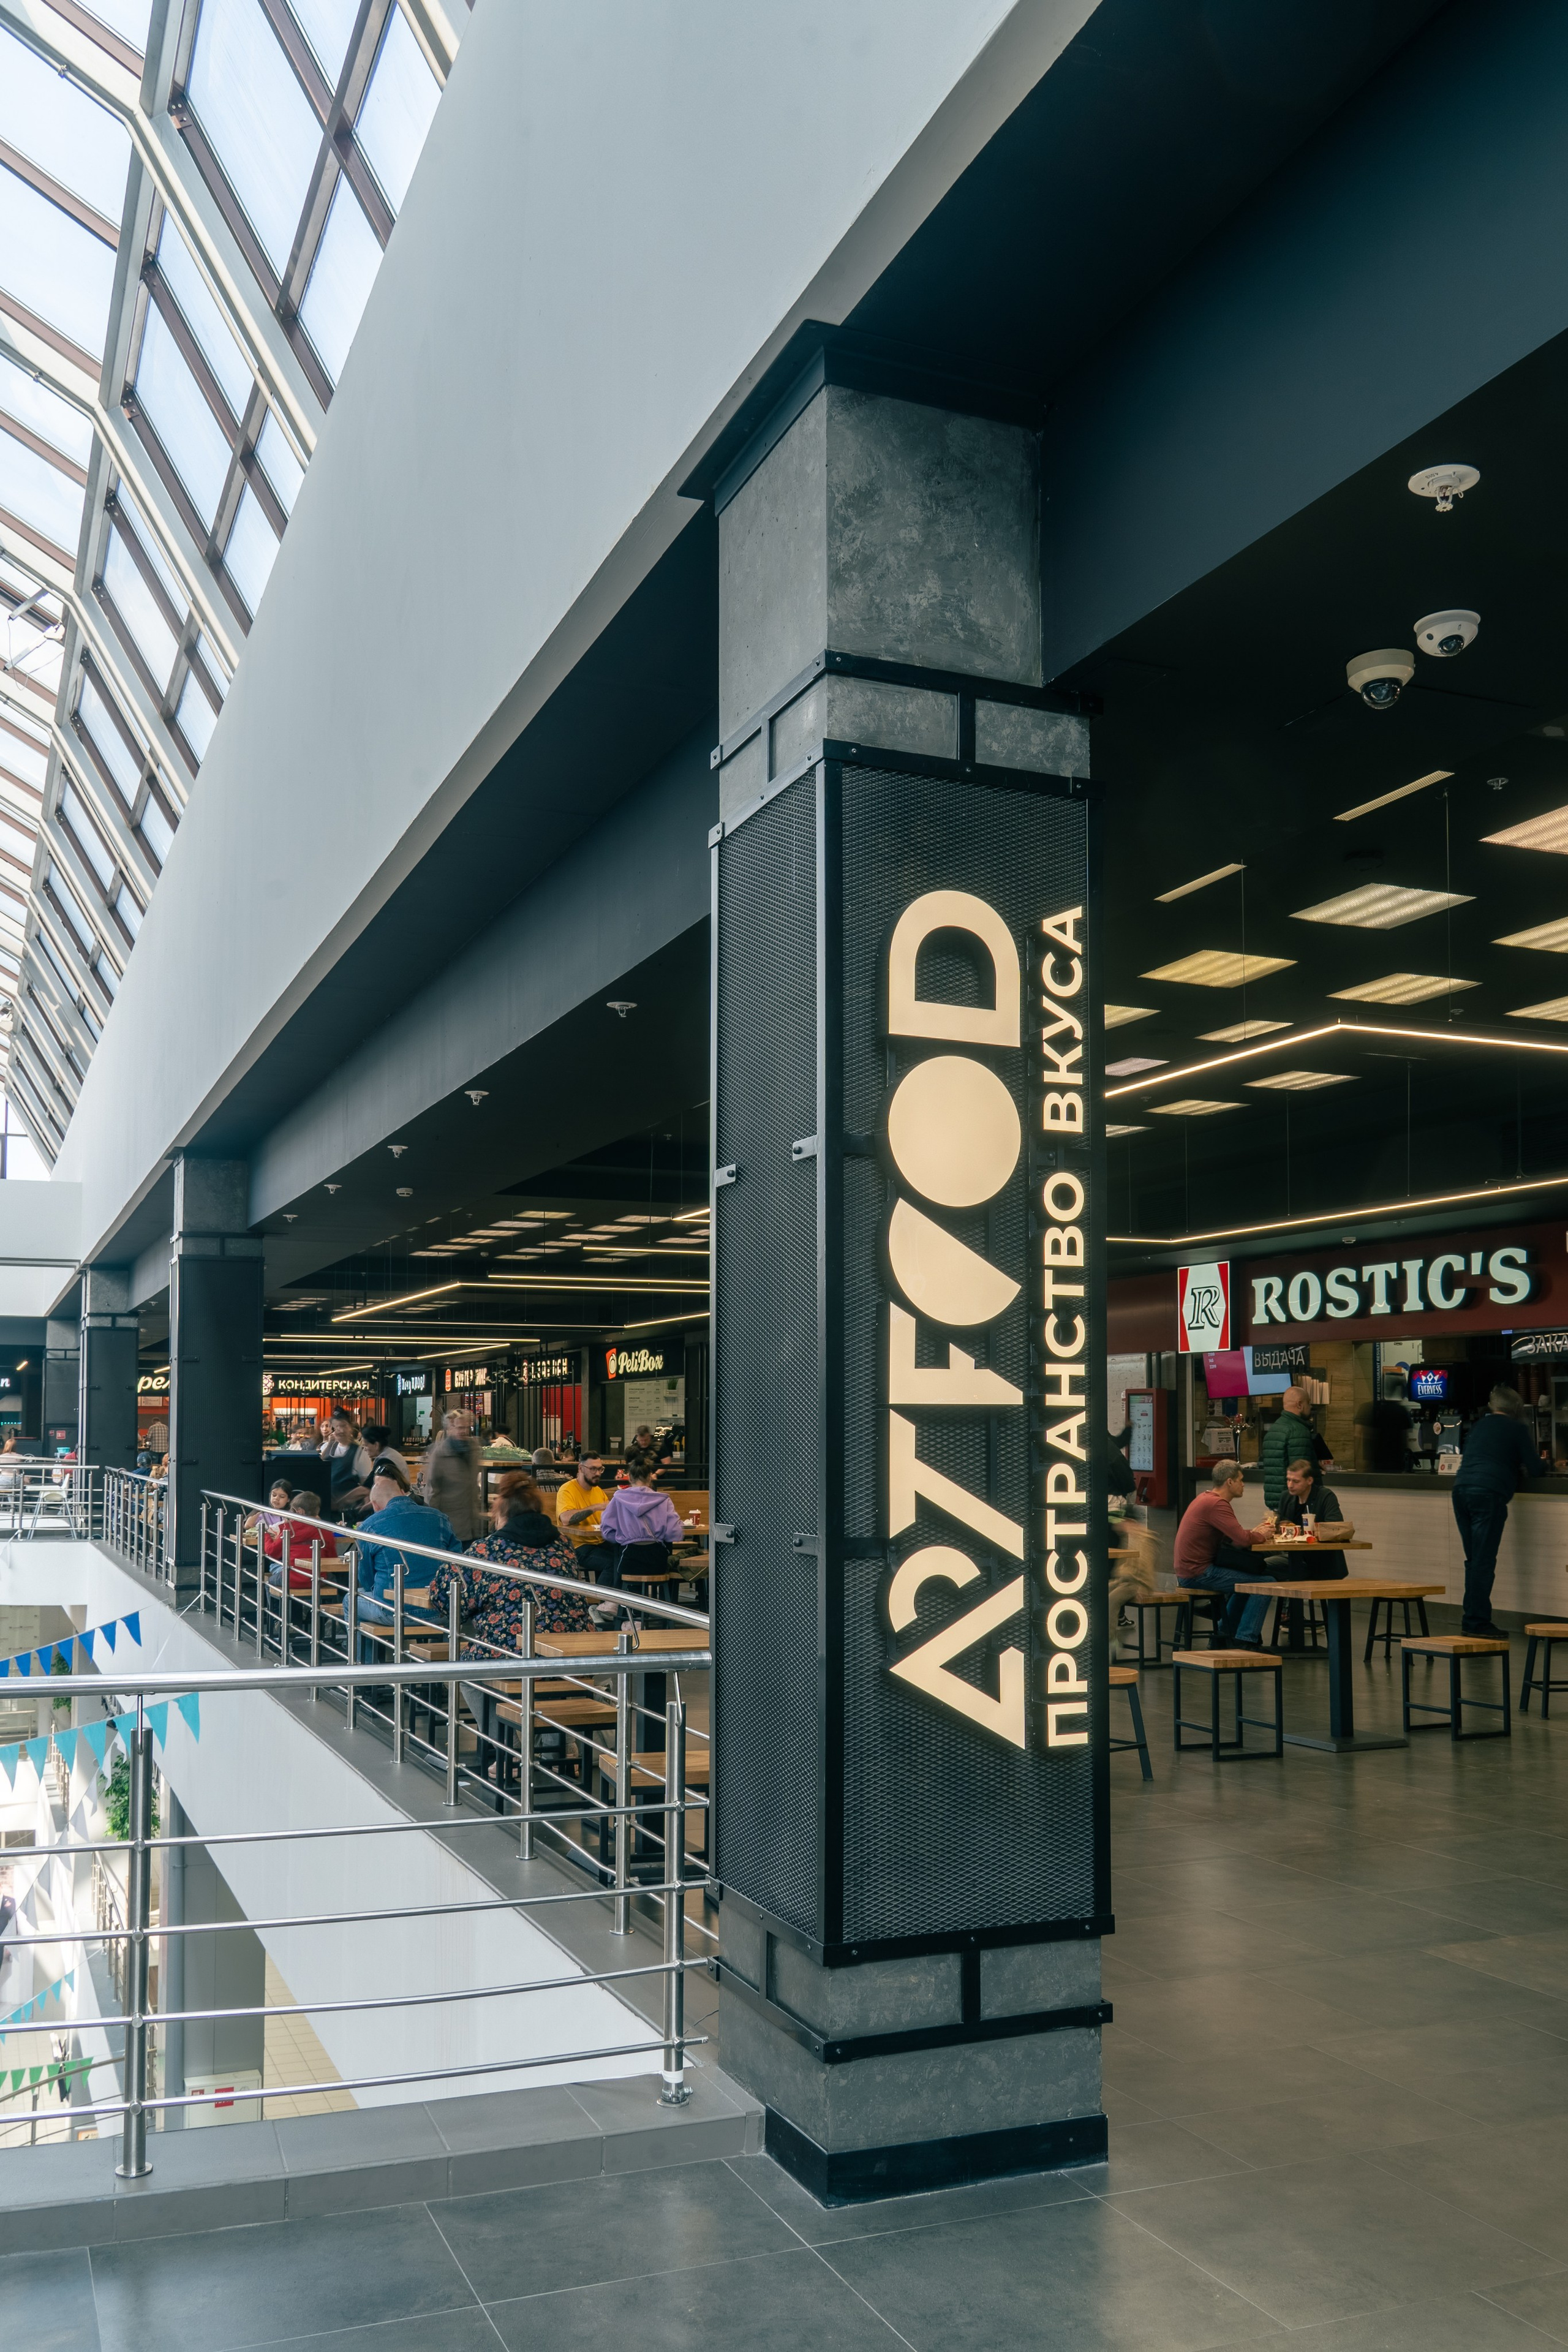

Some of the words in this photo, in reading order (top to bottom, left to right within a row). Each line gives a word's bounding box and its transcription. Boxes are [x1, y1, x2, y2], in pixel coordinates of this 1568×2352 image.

[1042, 906, 1083, 1134] ВКУСА
[889, 889, 1025, 1750] ARTFOOD
[1252, 1248, 1530, 1324] ROSTIC'S
[618, 1349, 663, 1374] PeliBox
[1254, 1349, 1305, 1370] ВЫДАЧА
[1417, 1384, 1442, 1395] EVERVESS
[1043, 1171, 1088, 1747] ПРОСТРАНСТВО
